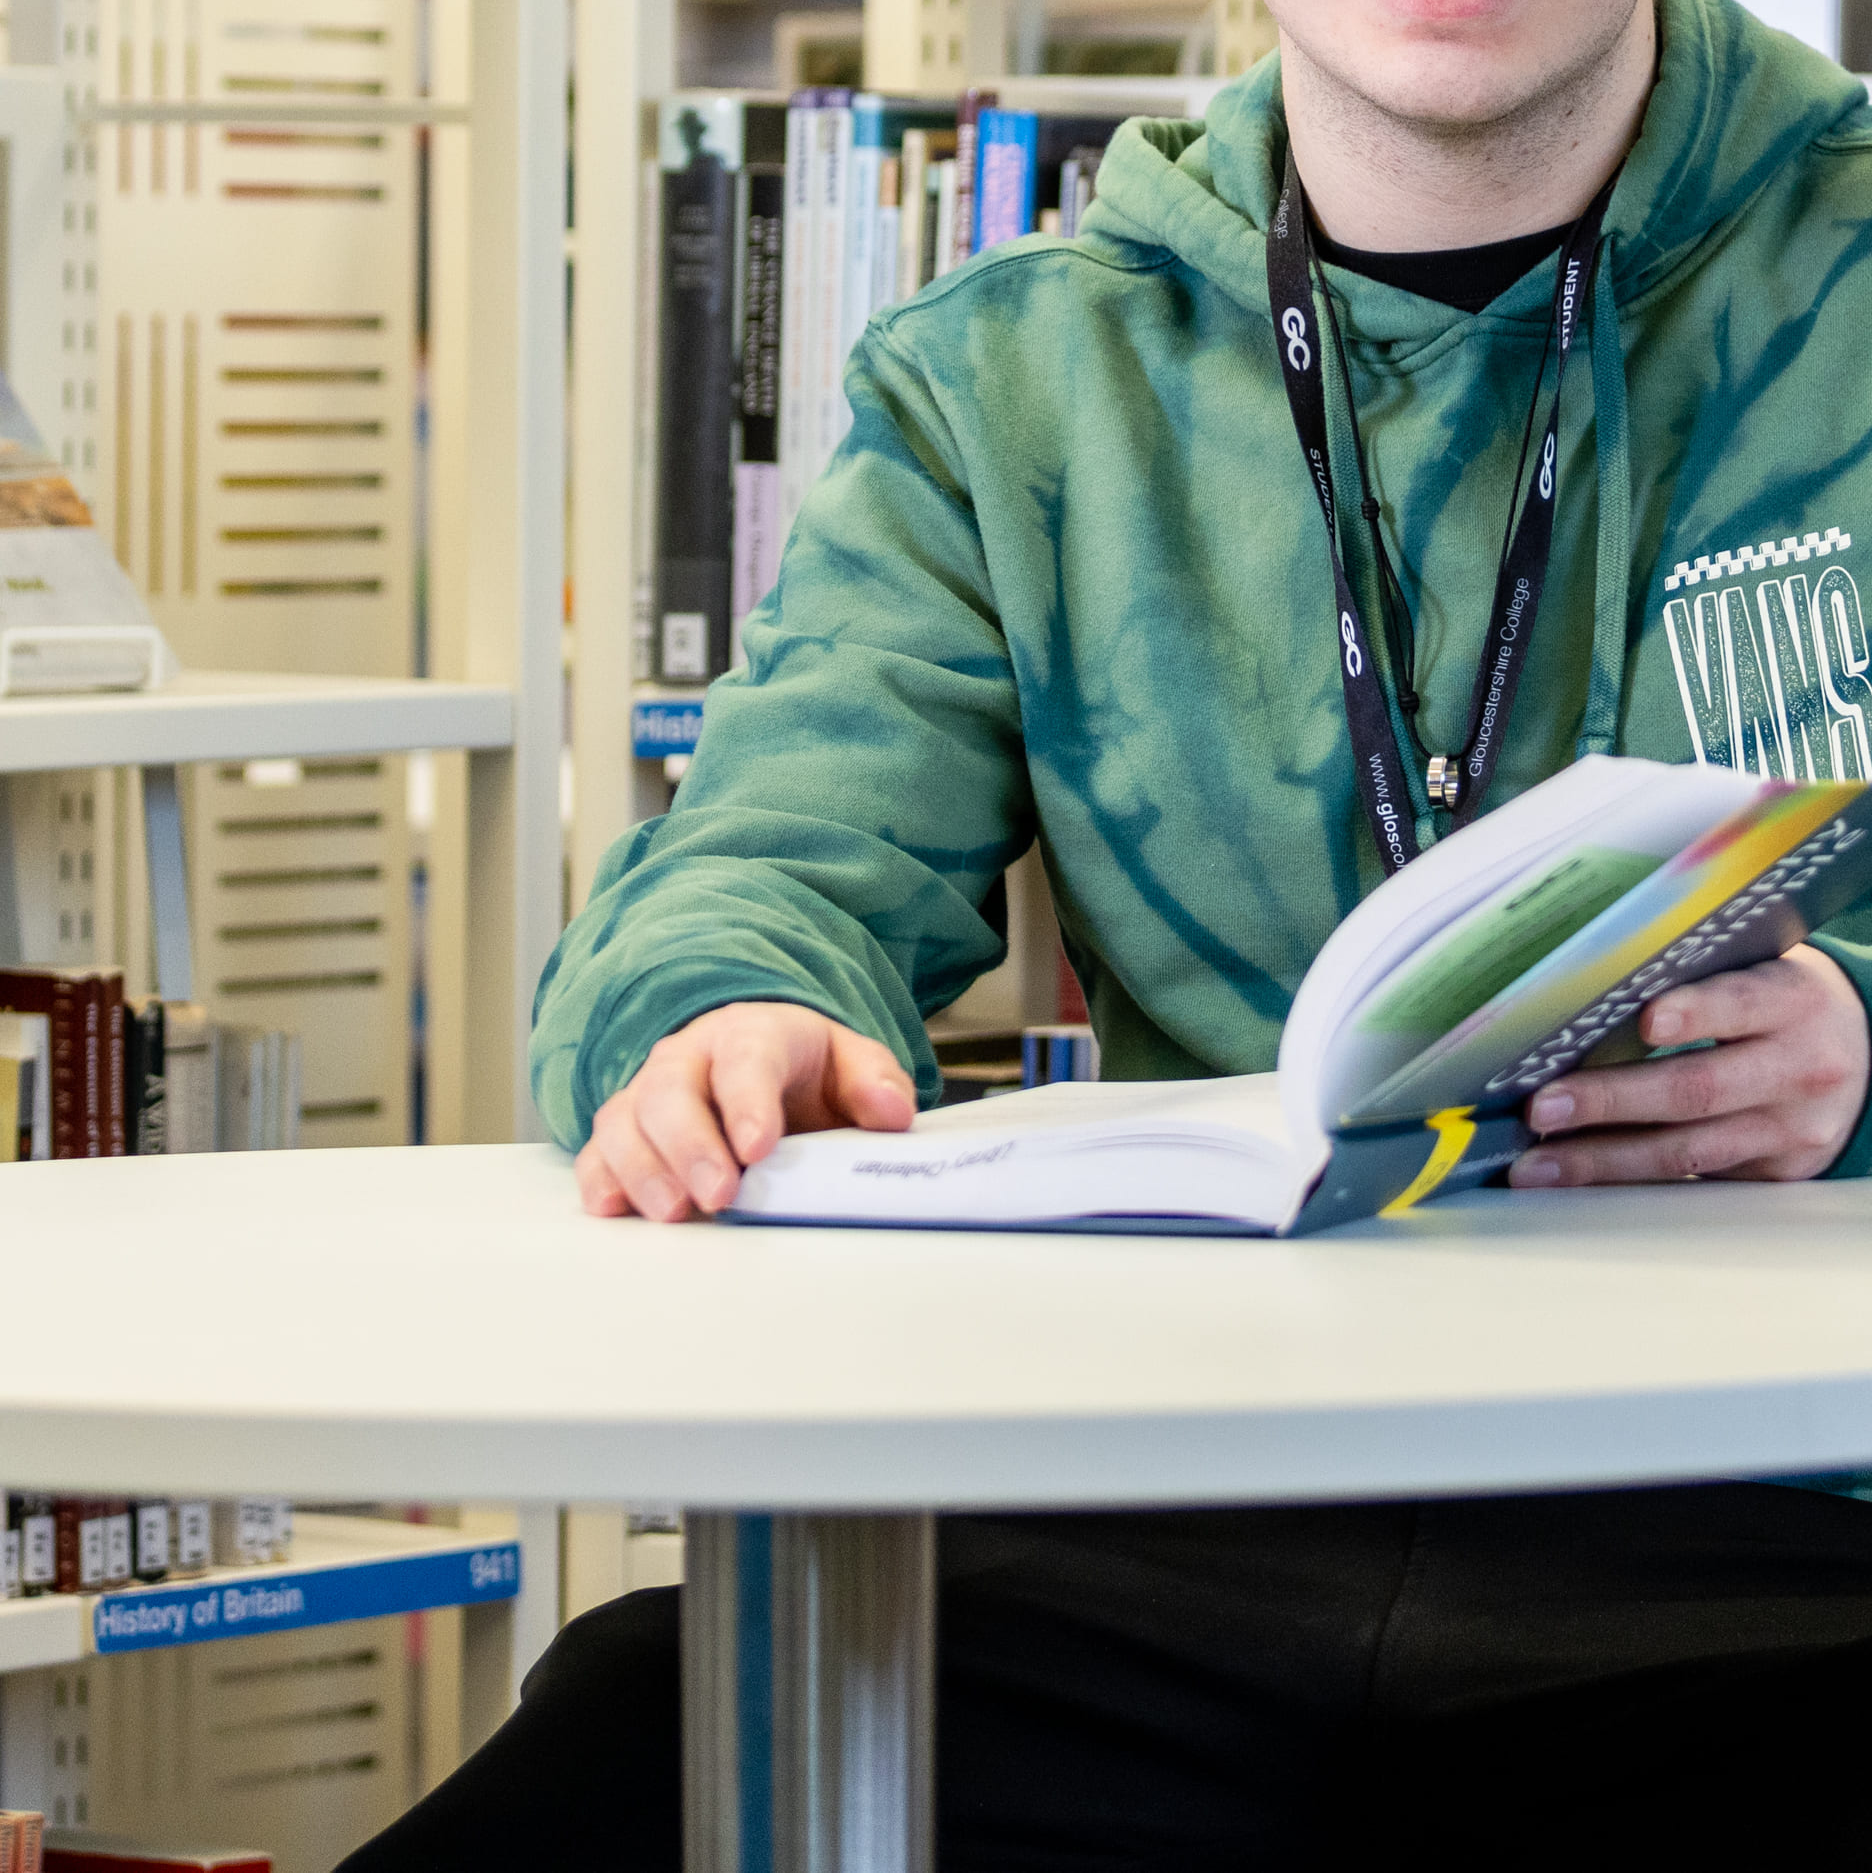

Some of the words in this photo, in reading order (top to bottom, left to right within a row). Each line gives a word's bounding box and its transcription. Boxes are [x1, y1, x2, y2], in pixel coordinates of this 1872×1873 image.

[1281, 305, 1312, 372] GC
[1559, 256, 1582, 352] STUDENT
[1537, 430, 1557, 501] GC
[1340, 610, 1363, 678] GC
[1468, 645, 1514, 779] Gloucestershire
[1500, 576, 1530, 643] College
[1485, 817, 1848, 1093] Cryptography
[1516, 975, 1673, 1090] Made
[1675, 826, 1868, 970] Simple
[96, 1601, 188, 1637] History
[191, 1591, 221, 1627] of
[223, 1582, 305, 1622] Britain
